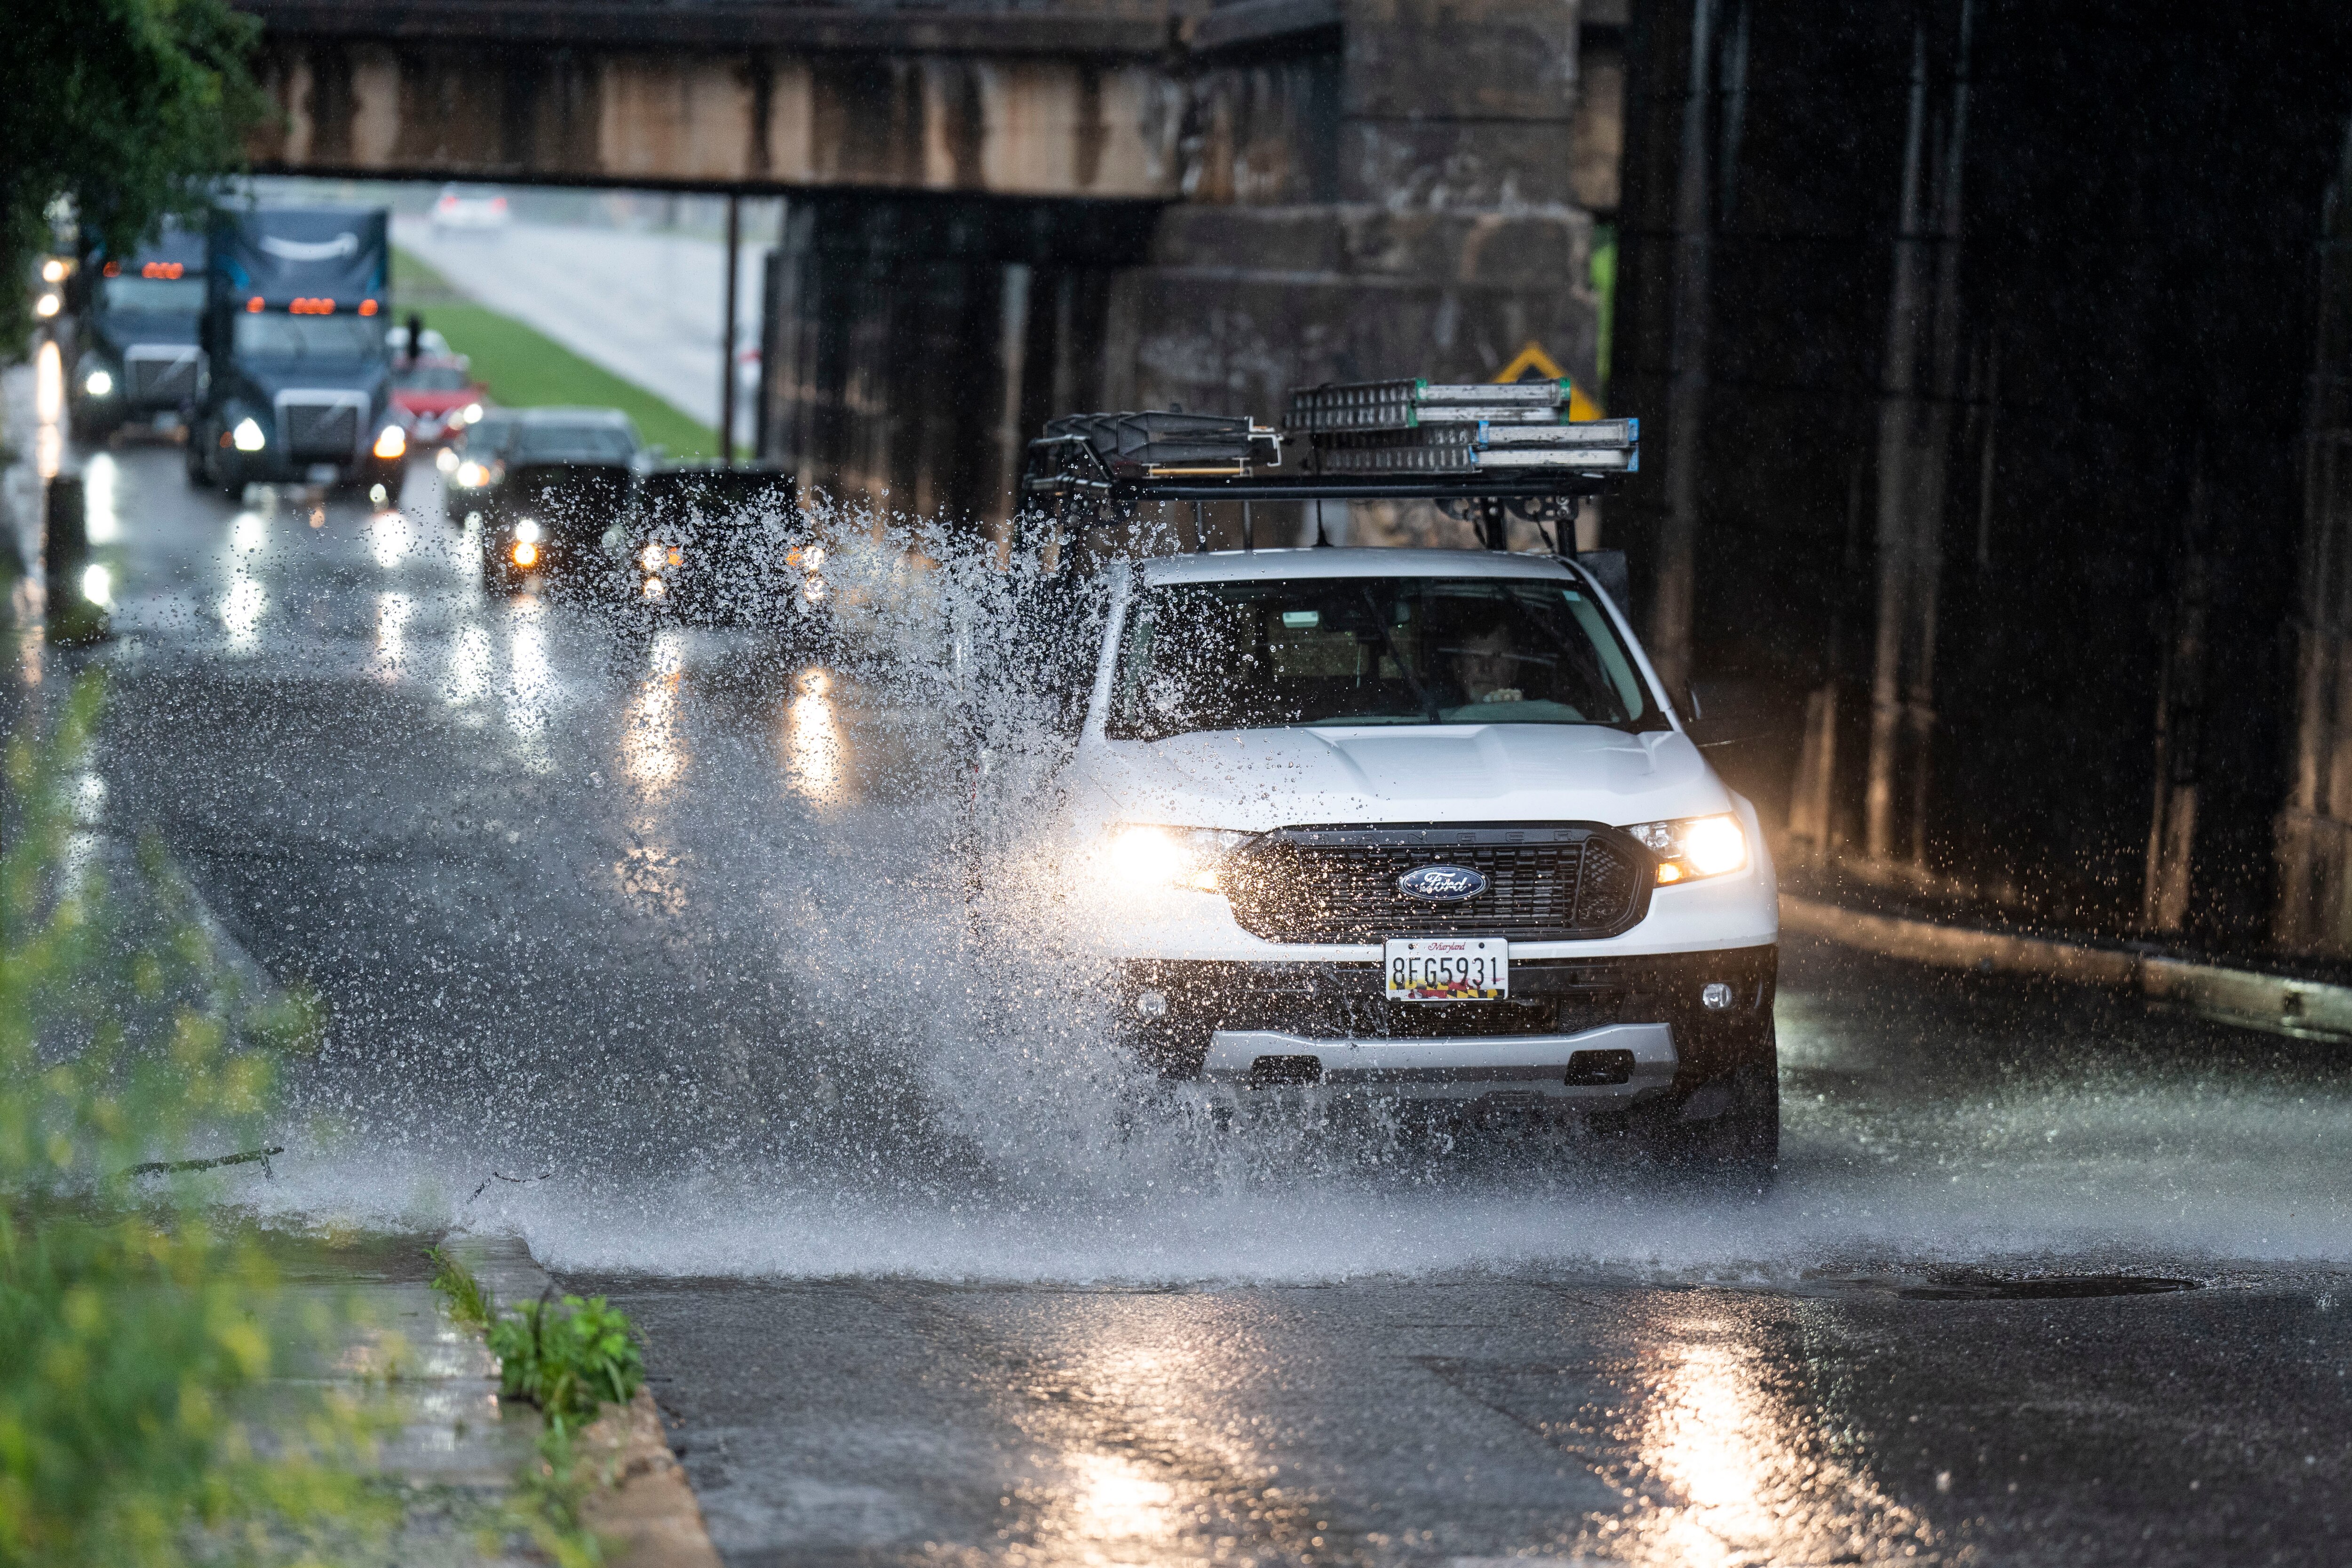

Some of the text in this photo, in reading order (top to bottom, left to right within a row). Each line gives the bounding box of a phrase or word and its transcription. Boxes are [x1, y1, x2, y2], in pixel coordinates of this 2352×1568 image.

[1310, 830, 1572, 844] RANGER
[1419, 872, 1468, 892] Ford
[1428, 942, 1465, 953] Maryland
